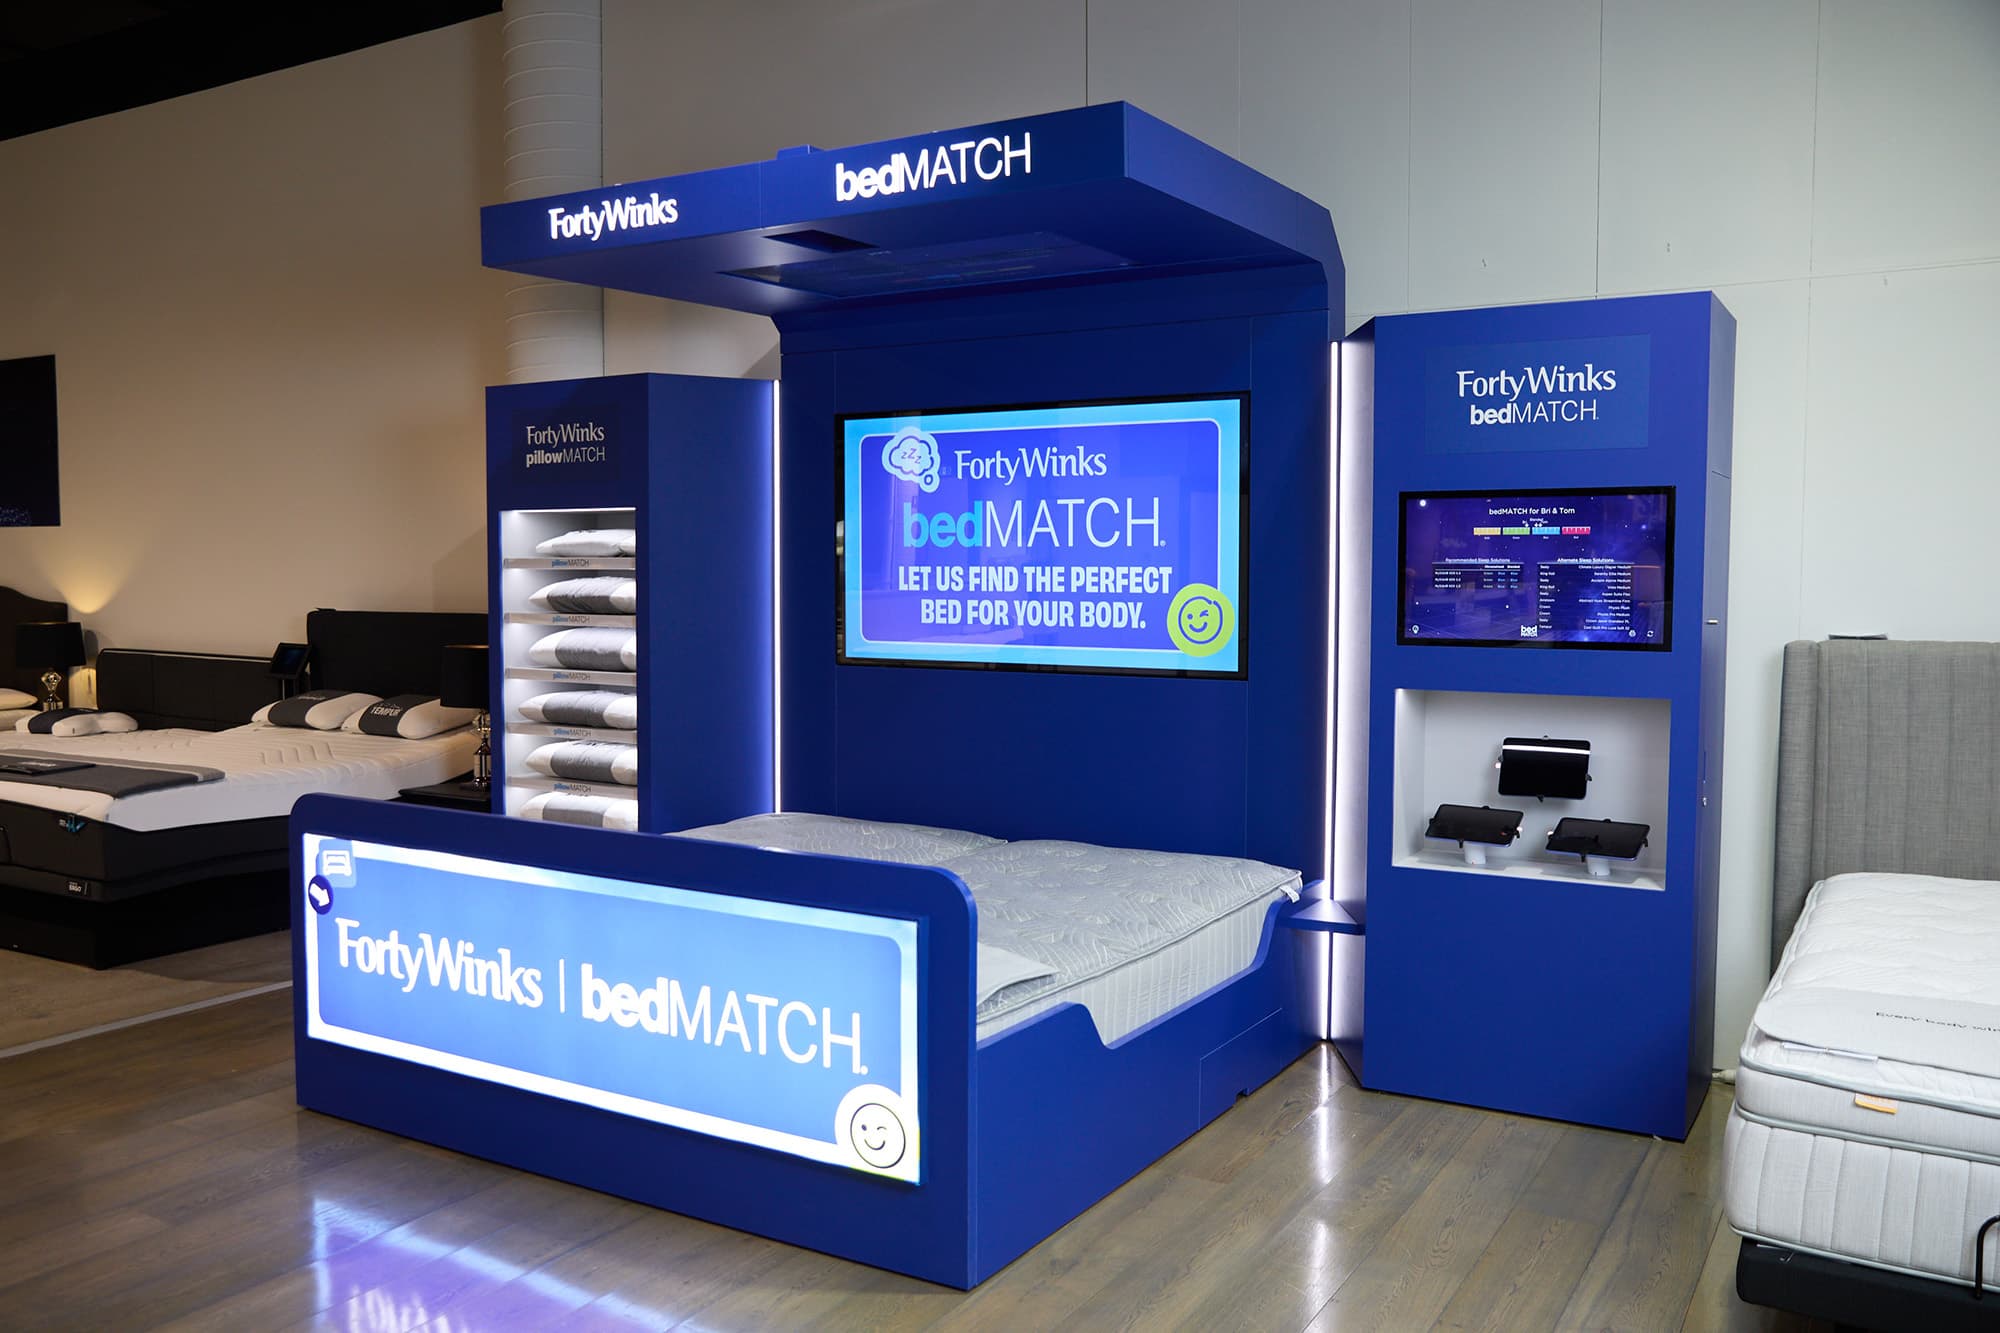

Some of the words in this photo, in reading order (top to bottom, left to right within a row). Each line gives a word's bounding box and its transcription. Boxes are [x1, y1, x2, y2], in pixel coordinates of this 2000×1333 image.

[834, 131, 1031, 202] bedMATCH
[547, 192, 679, 241] FortyWinks
[1456, 363, 1617, 402] FortyWinks
[526, 422, 605, 449] FortyWinks
[526, 446, 606, 468] pillowMATCH
[954, 445, 1108, 486] FortyWinks
[1488, 507, 1528, 515] bedMATCH
[1529, 507, 1540, 515] for
[898, 565, 931, 592] LET
[937, 565, 965, 593] US
[969, 566, 1018, 593] FIND
[1023, 566, 1066, 594] THE
[1071, 566, 1173, 595] PERFECT
[920, 598, 962, 625] BED
[966, 599, 1009, 627] FOR
[1013, 599, 1074, 628] YOUR
[1080, 600, 1147, 629] BODY.
[335, 917, 543, 1009] FortyWinks
